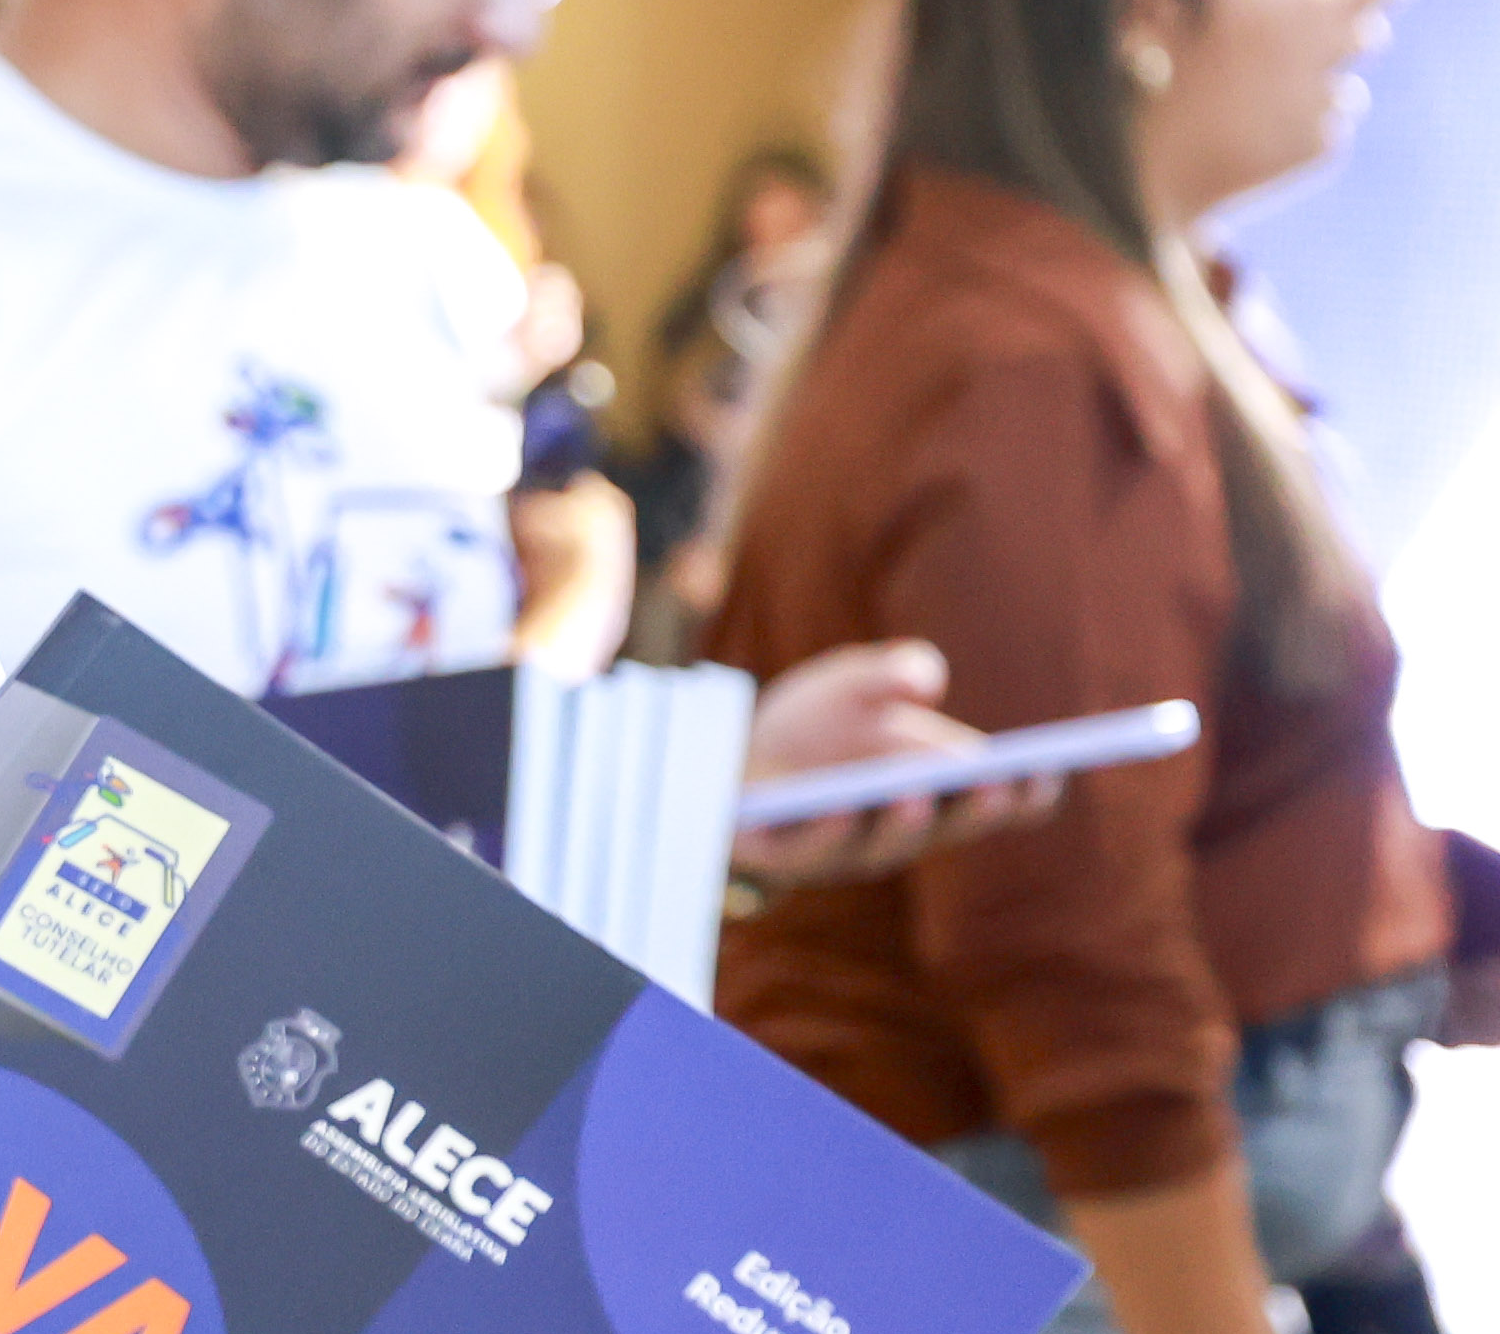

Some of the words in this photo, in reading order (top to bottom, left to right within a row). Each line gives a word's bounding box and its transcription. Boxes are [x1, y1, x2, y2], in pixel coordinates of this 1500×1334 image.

[20, 903, 133, 975] CONSELHO
[46, 884, 130, 938] ALECE
[22, 926, 109, 985] TUTELAR
[326, 1077, 553, 1246] ALECE
[408, 1184, 507, 1266] LEGISLATIVA
